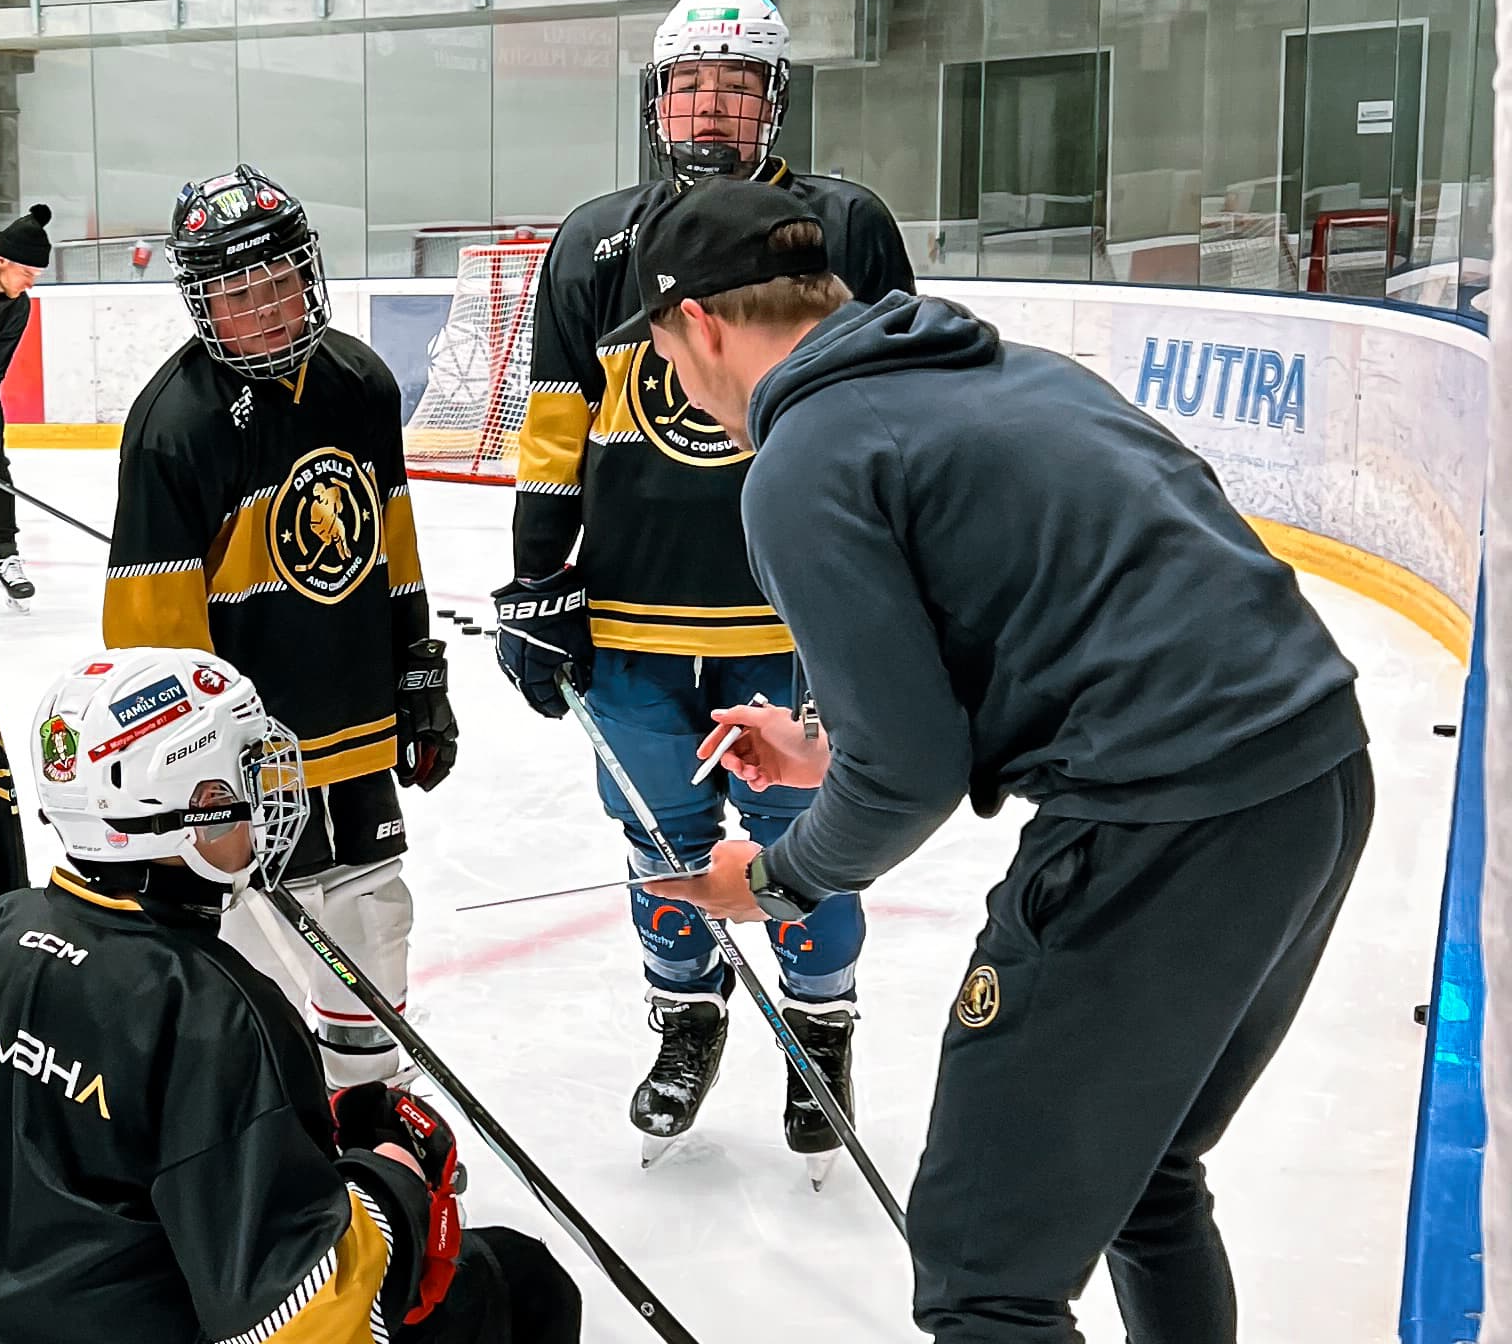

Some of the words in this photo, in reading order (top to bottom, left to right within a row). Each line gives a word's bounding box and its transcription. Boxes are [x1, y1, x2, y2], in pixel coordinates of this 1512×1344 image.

[1136, 336, 1307, 433] HUTIRA
[666, 429, 688, 447] AND
[294, 469, 315, 491] DB
[315, 460, 353, 479] SKILLS
[306, 576, 329, 590] AND
[18, 930, 89, 967] CCM
